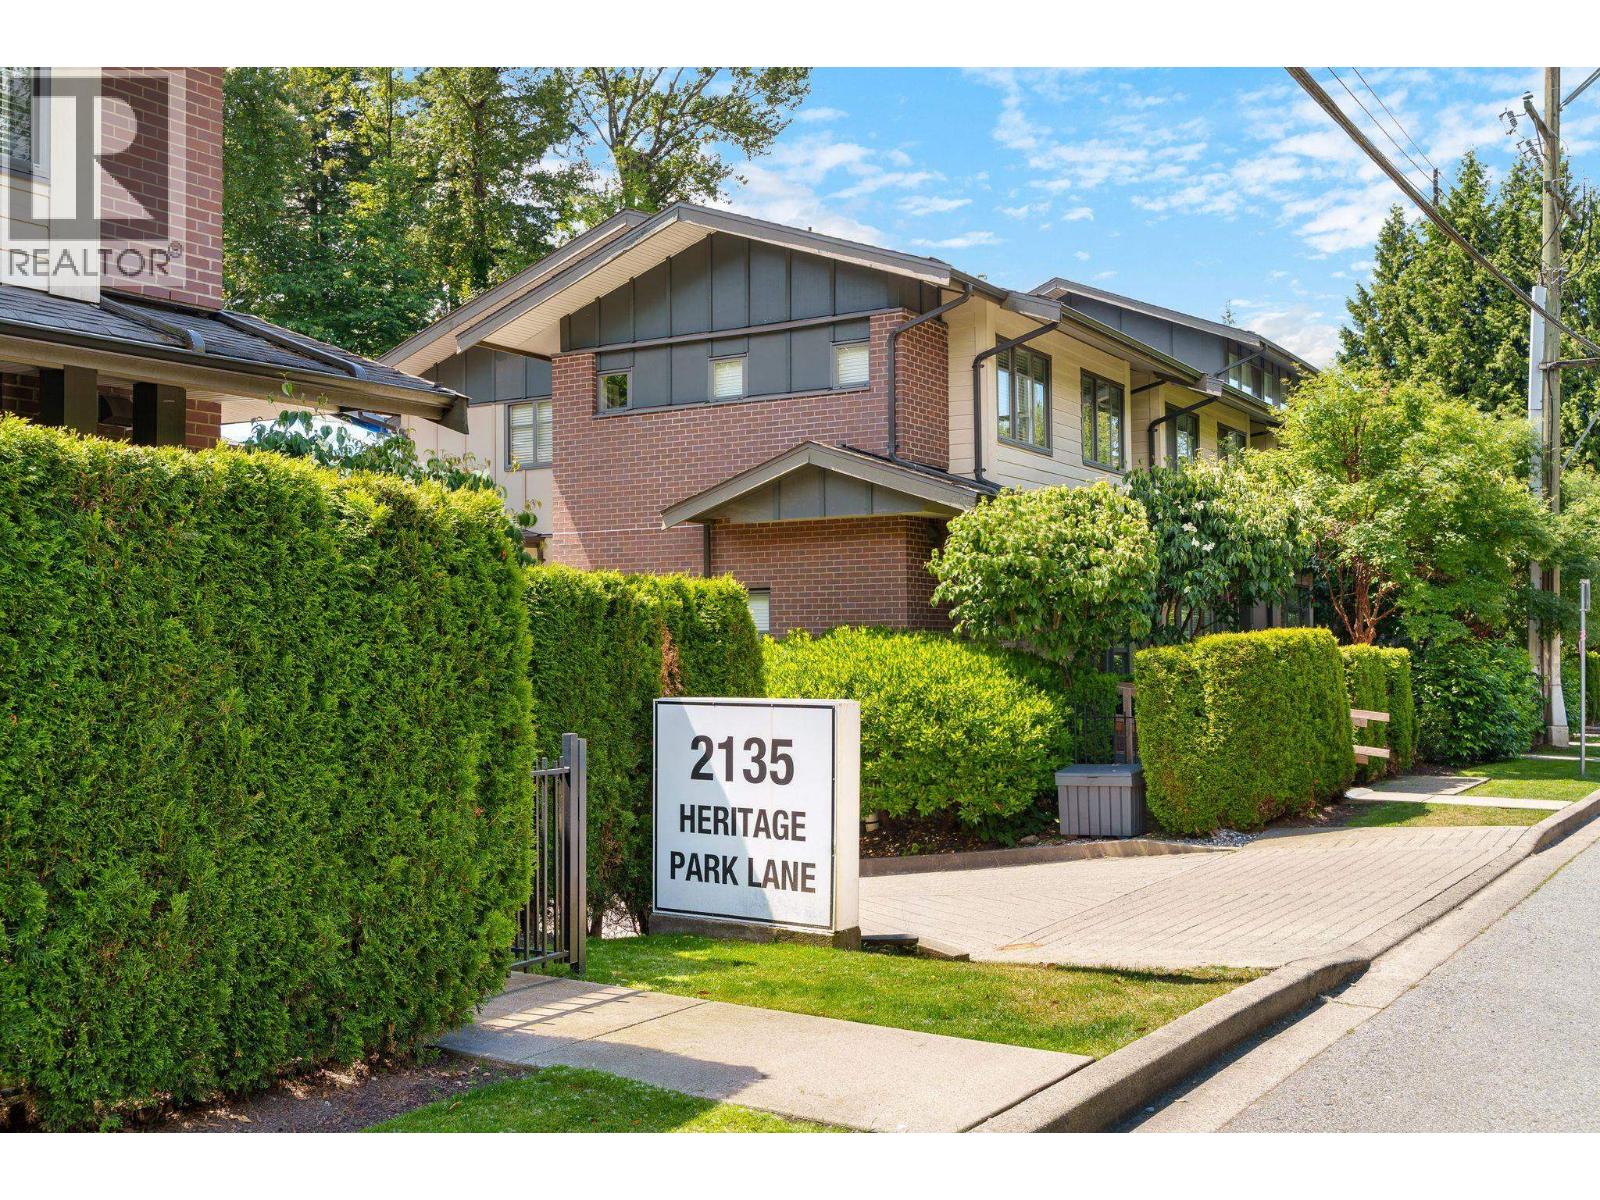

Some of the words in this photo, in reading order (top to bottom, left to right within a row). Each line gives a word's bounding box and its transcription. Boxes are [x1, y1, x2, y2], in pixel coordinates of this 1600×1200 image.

[690, 735, 795, 786] 2135
[679, 803, 806, 842] HERITAGE
[669, 850, 739, 886] PARK
[747, 857, 817, 894] LANE
